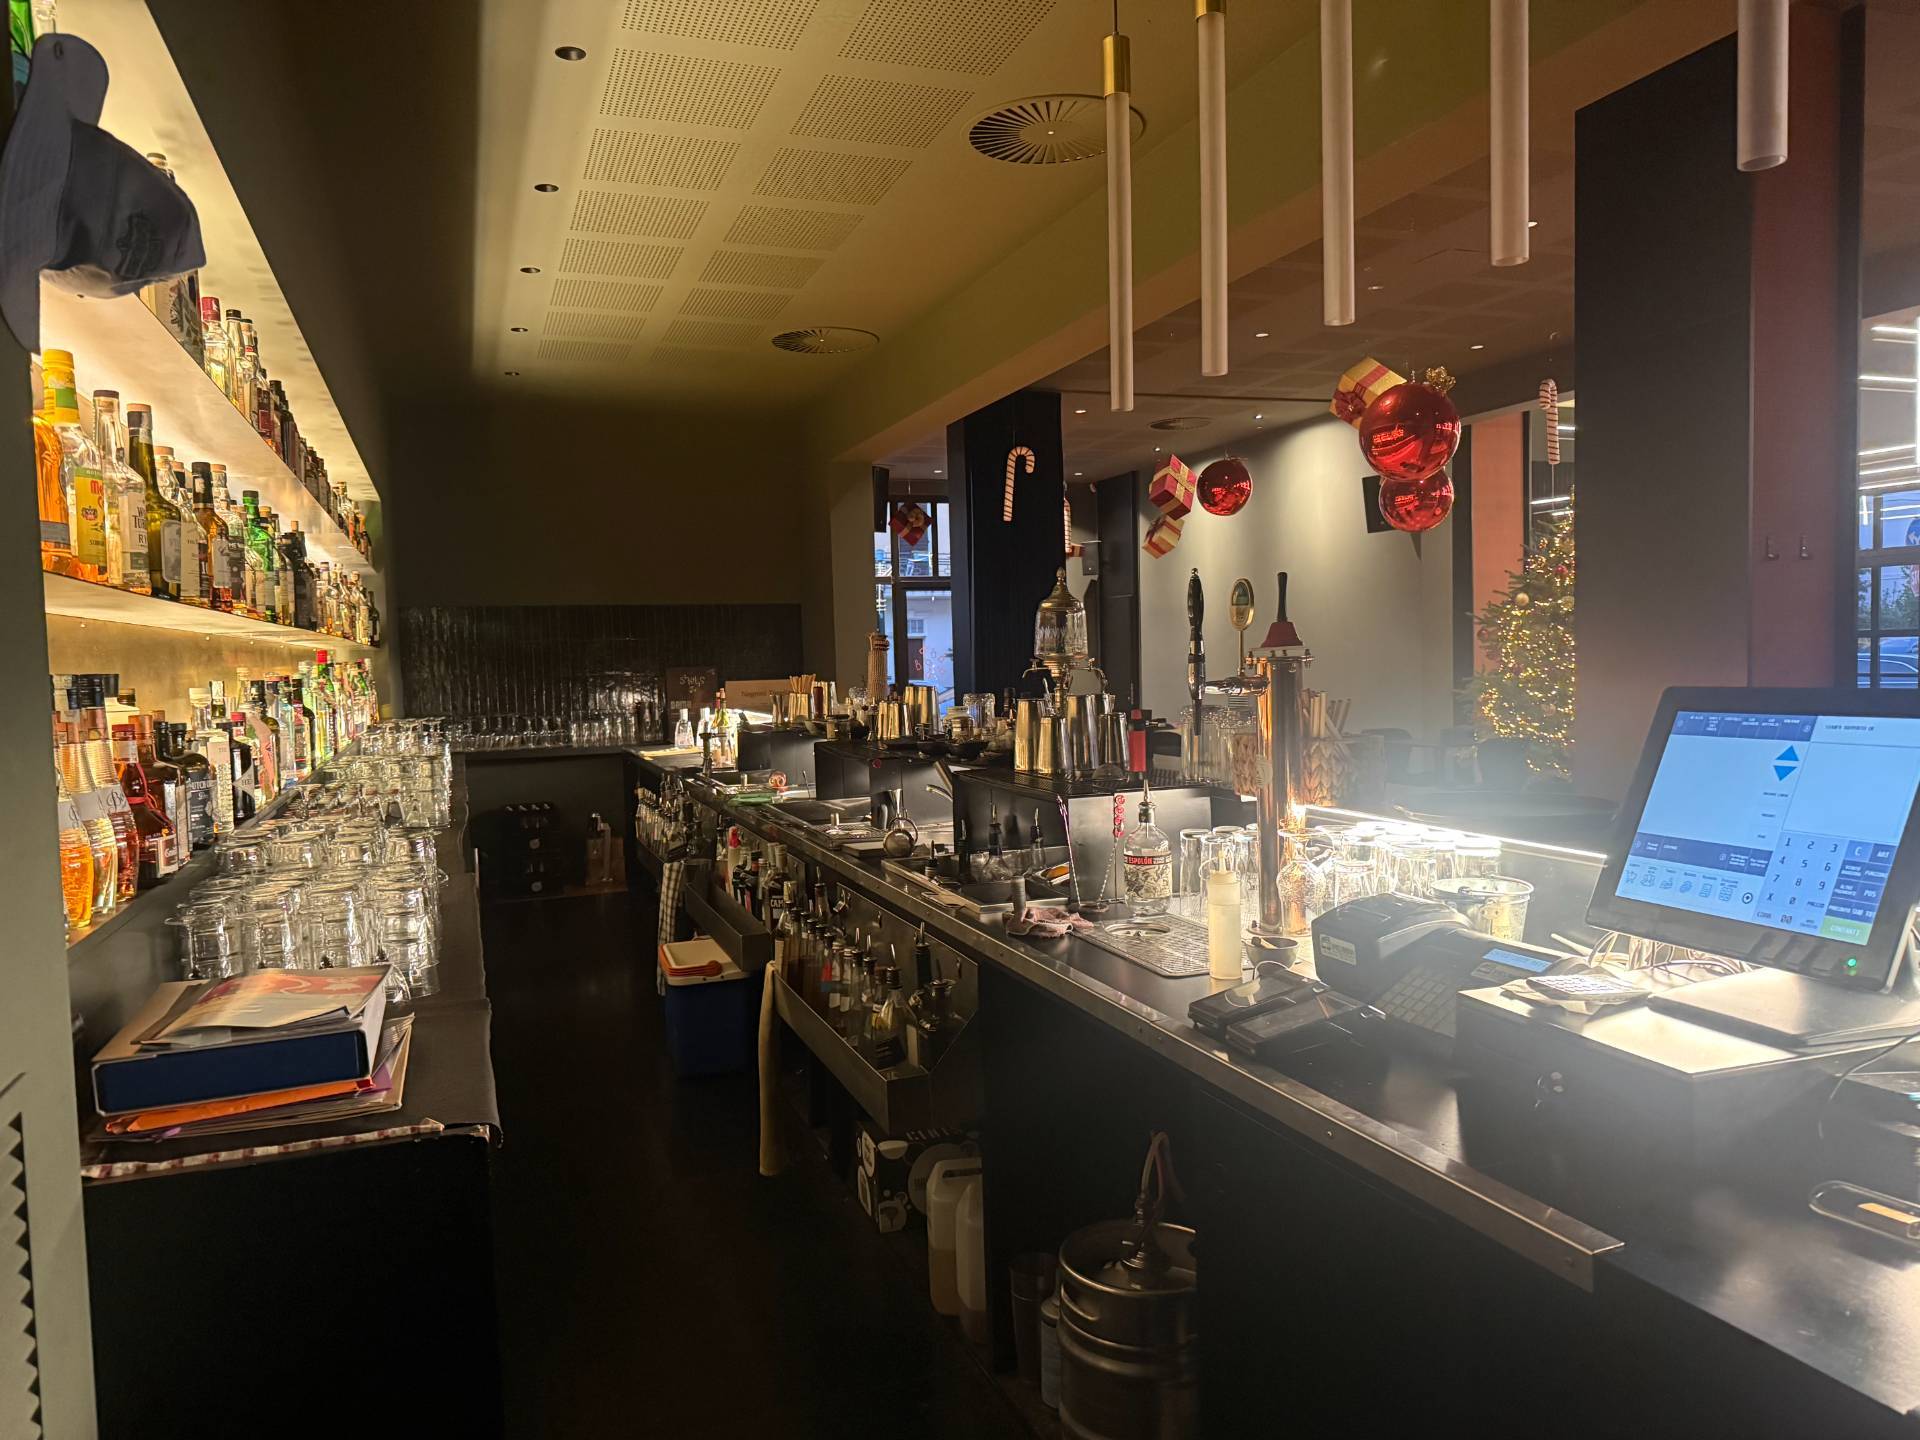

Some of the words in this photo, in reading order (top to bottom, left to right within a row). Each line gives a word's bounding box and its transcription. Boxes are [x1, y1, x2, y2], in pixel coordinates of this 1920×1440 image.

[1785, 837, 1791, 846] 1
[1807, 841, 1815, 849] 2
[1830, 844, 1838, 852] 3
[1855, 846, 1863, 856] C
[1779, 856, 1785, 864] 4
[1800, 859, 1808, 868] 5
[1824, 862, 1831, 871] 6
[1773, 874, 1780, 882] 7
[1795, 878, 1802, 887] 8
[1818, 881, 1825, 890] 9
